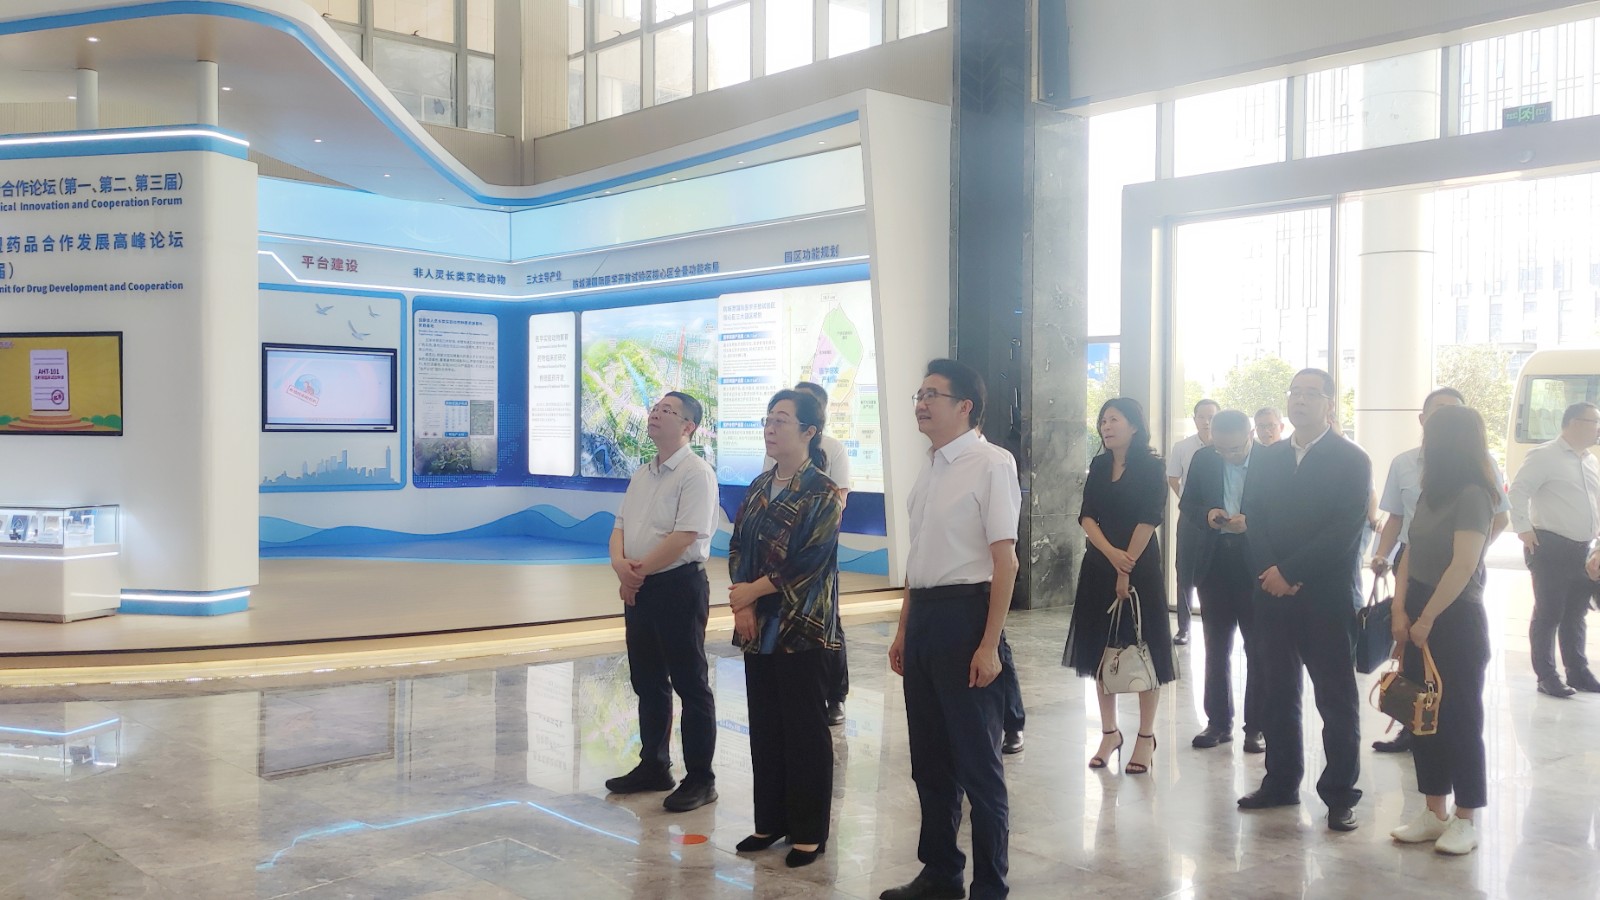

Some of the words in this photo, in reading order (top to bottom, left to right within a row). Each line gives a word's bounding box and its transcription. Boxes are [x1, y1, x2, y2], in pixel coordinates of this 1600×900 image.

[0, 202, 16, 211] ical
[20, 200, 69, 211] Innovation
[72, 199, 89, 209] and
[91, 197, 150, 210] Cooperation
[152, 197, 182, 206] Forum
[0, 231, 184, 253] 药品合作发展高峰论坛
[784, 244, 840, 264] 园区功能规划
[301, 255, 359, 273] 平台建设
[413, 267, 507, 286] 非人灵长类实验动物
[526, 270, 562, 285] 三大主导产业
[13, 284, 25, 293] for
[26, 284, 48, 295] Drug
[49, 283, 108, 294] Development
[109, 282, 126, 291] and
[128, 280, 184, 292] Cooperation
